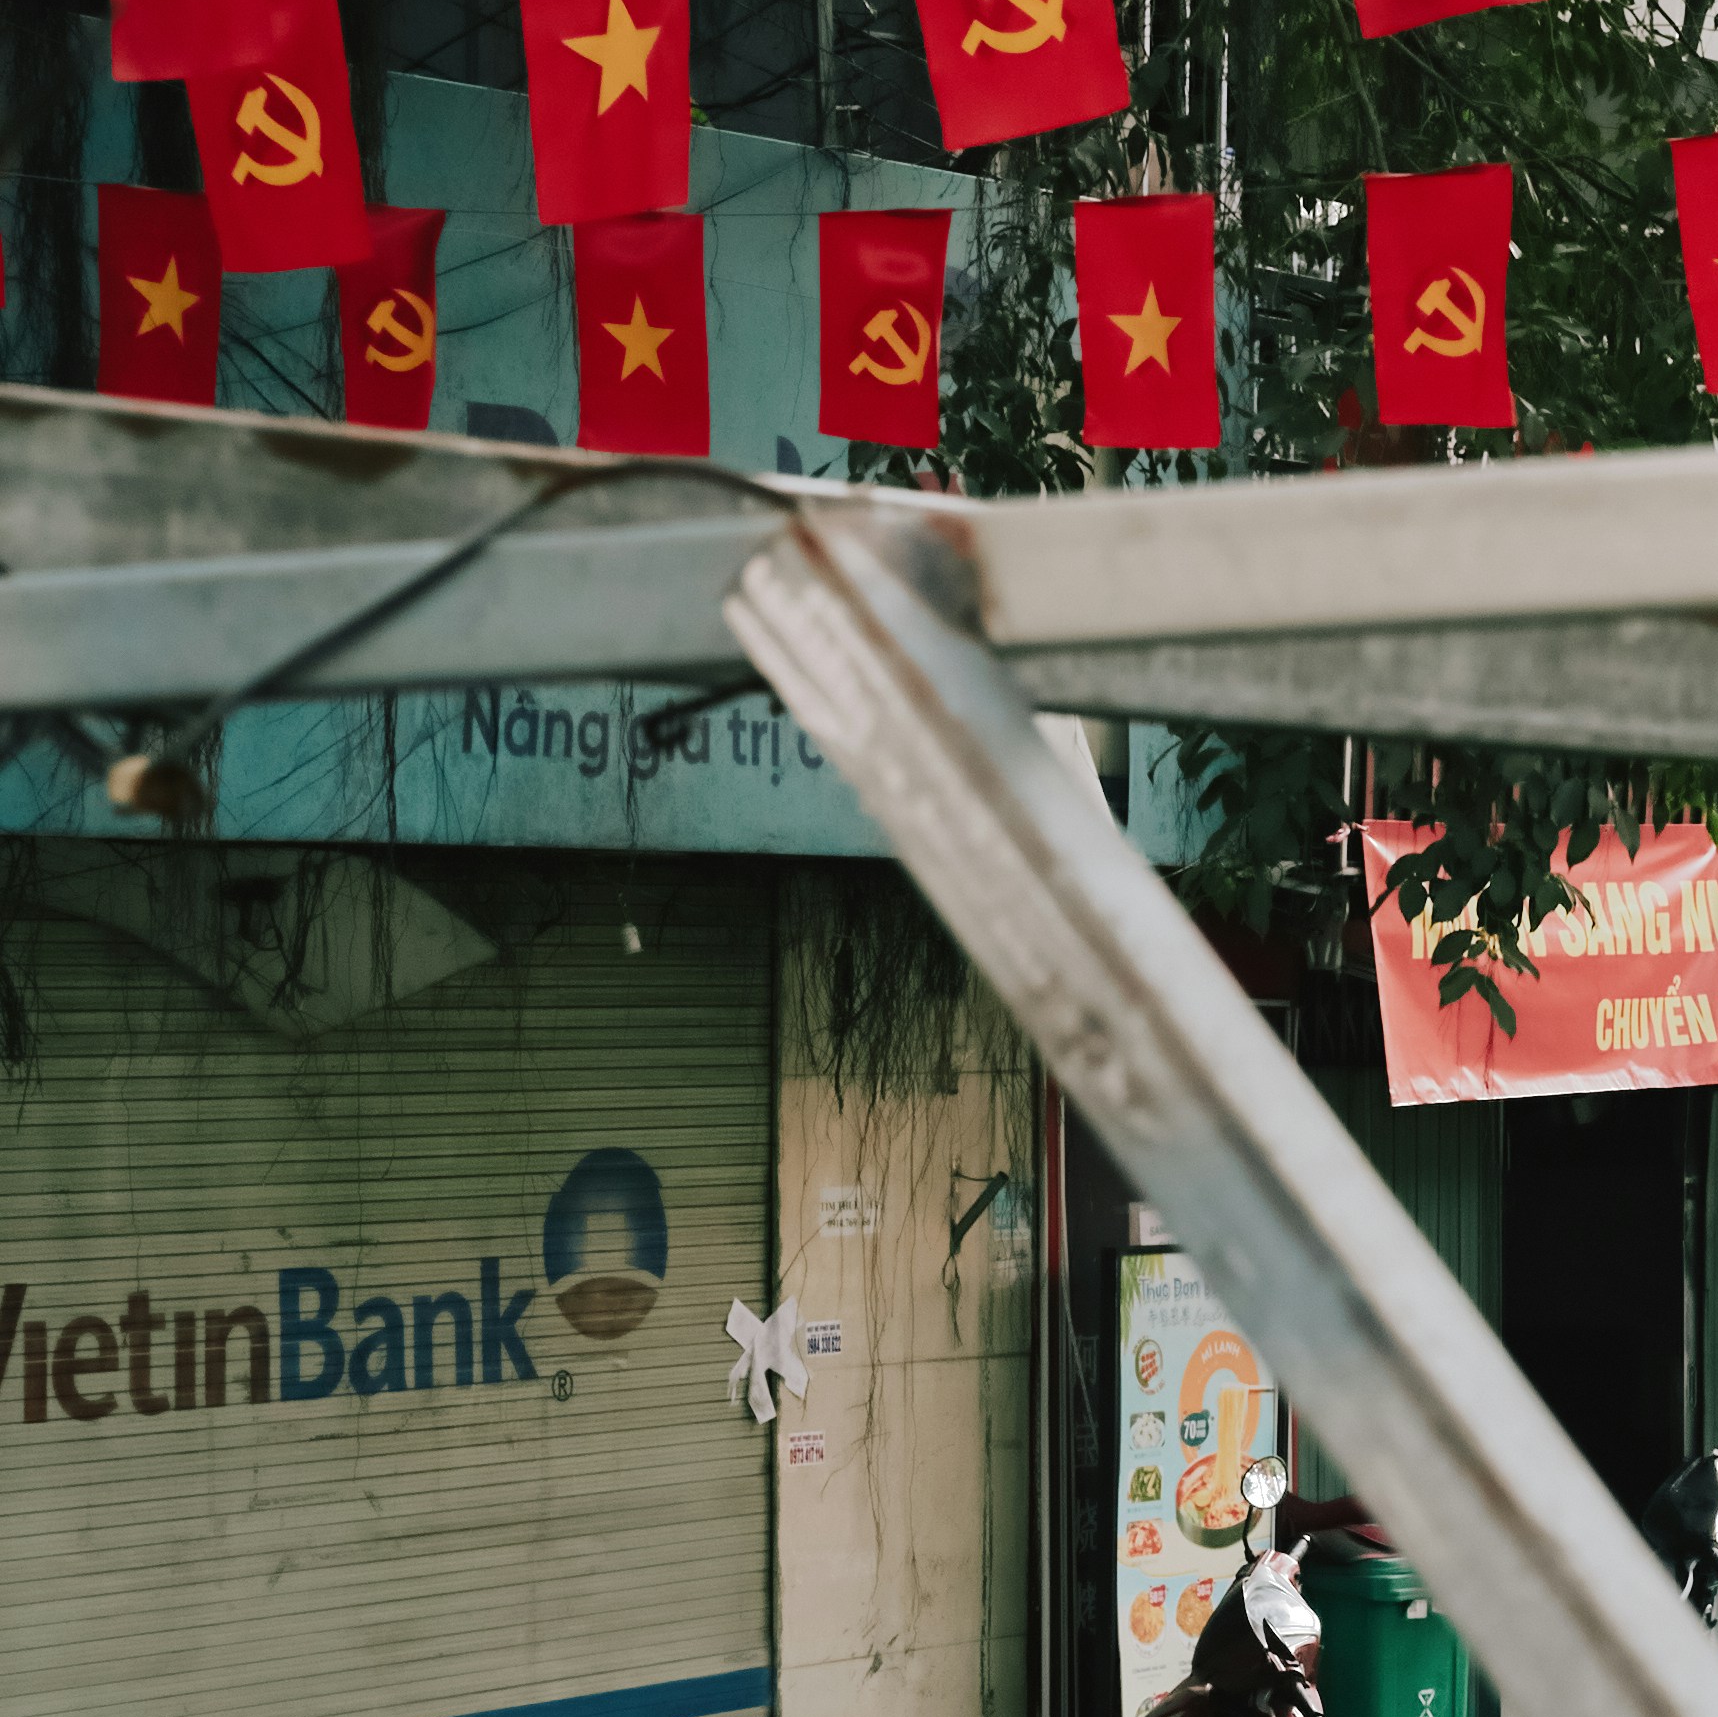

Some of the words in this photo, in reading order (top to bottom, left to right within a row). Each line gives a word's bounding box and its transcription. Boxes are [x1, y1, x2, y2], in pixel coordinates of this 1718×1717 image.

[461, 686, 610, 779] Nâng
[727, 707, 781, 787] trị
[1556, 881, 1669, 957] SANG
[1596, 974, 1717, 1050] CHUYỂN
[1184, 1420, 1196, 1439] 70
